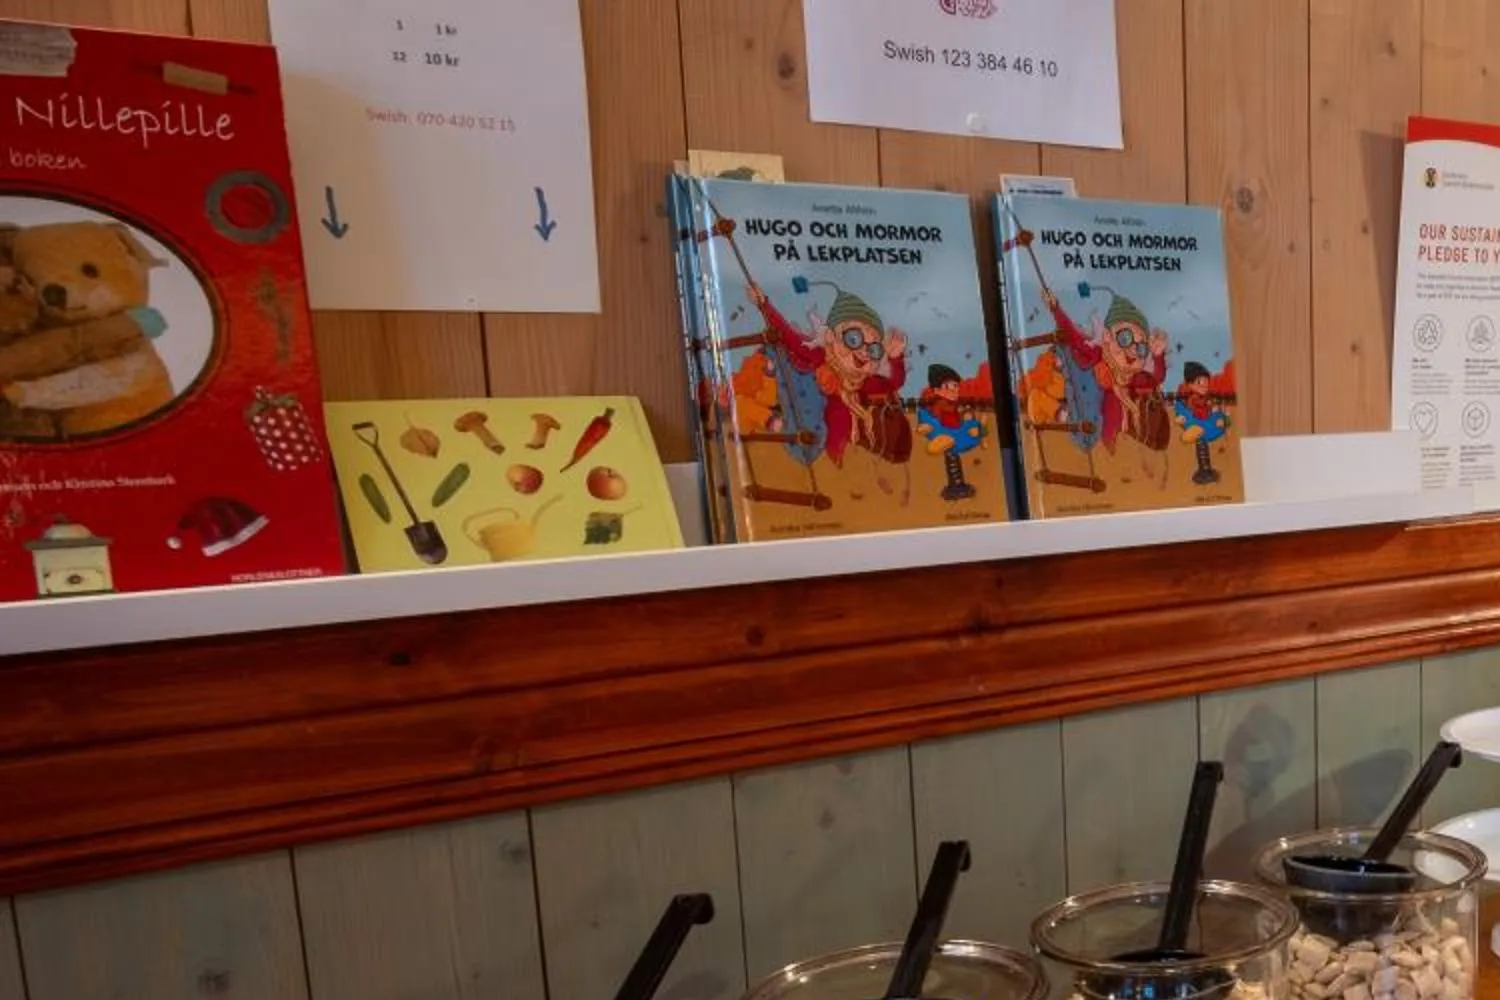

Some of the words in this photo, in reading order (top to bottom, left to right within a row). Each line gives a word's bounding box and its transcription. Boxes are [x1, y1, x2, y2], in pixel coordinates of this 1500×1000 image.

[425, 52, 442, 65] 10
[445, 54, 460, 66] kr
[883, 39, 935, 64] Swish
[941, 49, 971, 68] 123
[976, 52, 1007, 71] 384
[1012, 57, 1033, 75] 46
[1039, 60, 1059, 77] 10
[15, 92, 235, 149] Nillepille
[9, 147, 87, 169] boken
[745, 219, 802, 236] HUGO
[809, 220, 849, 239] OCH
[855, 223, 943, 243] MORMOR
[1041, 229, 1087, 246] HUGO
[1092, 231, 1123, 249] OCH
[1129, 233, 1199, 252] MORMOR
[1419, 223, 1447, 240] OUR
[773, 239, 801, 261] PÅ
[807, 244, 923, 264] LEKPLATSEN
[1063, 249, 1085, 269] PÅ
[1089, 253, 1182, 271] LEKPLATSEN
[1417, 245, 1470, 263] PLEDGE
[1474, 248, 1489, 264] TO
